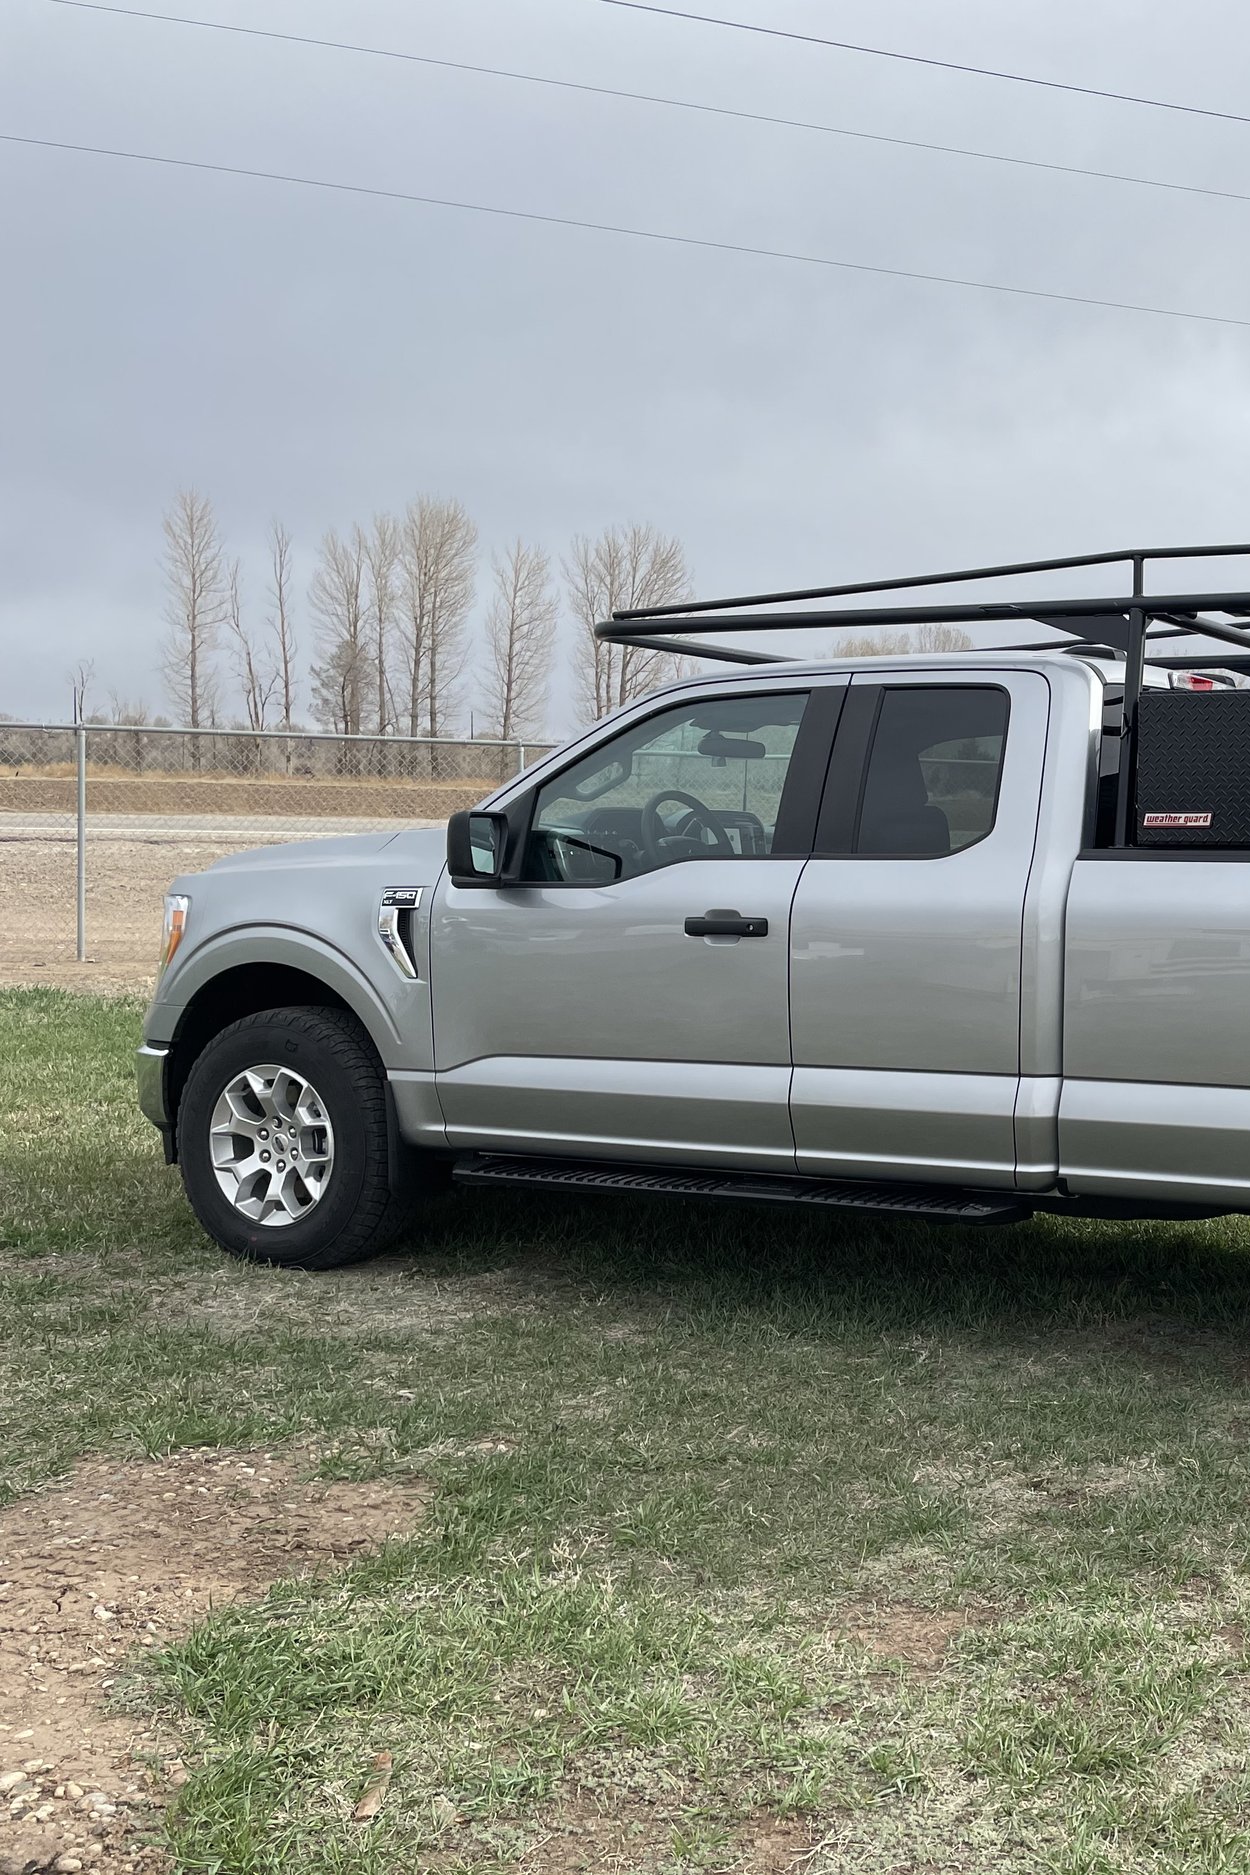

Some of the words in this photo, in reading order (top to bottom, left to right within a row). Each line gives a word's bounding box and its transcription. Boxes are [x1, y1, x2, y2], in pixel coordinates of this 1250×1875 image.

[1146, 814, 1182, 823] weather
[1183, 814, 1209, 824] guard
[383, 891, 417, 900] F-150
